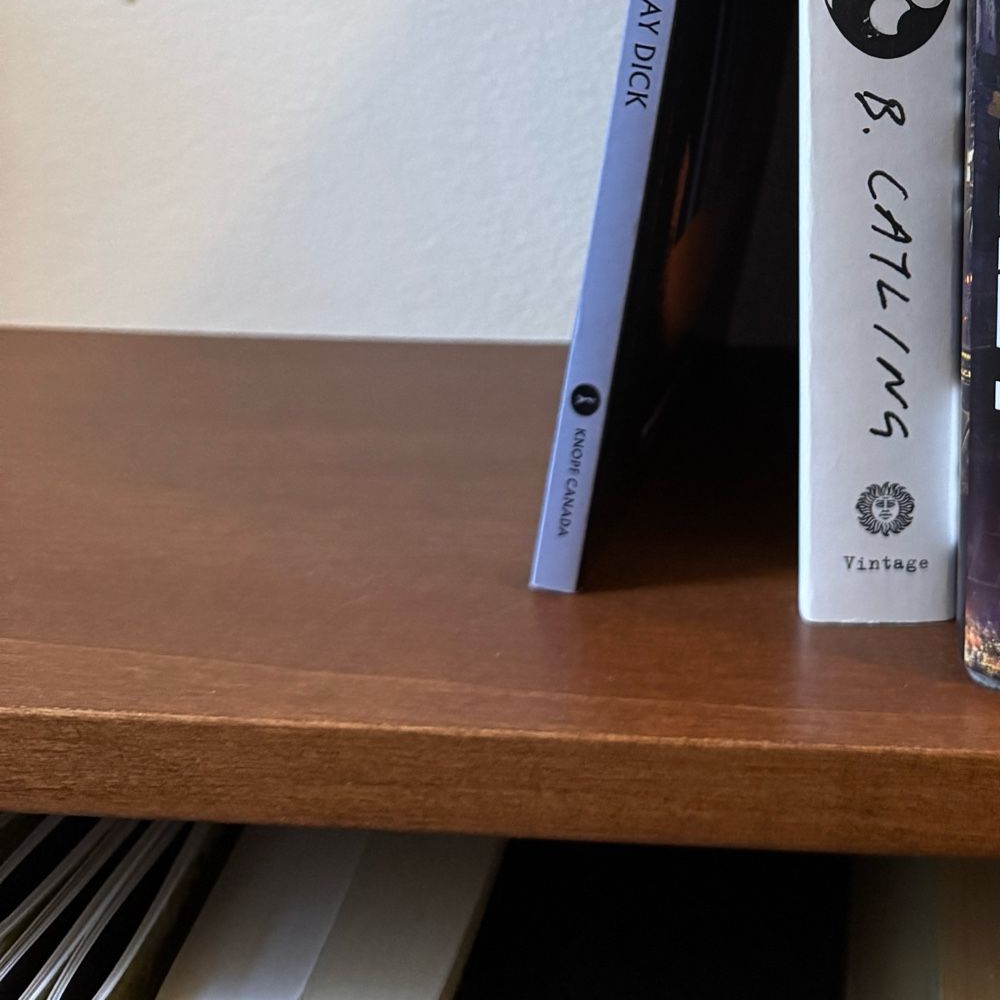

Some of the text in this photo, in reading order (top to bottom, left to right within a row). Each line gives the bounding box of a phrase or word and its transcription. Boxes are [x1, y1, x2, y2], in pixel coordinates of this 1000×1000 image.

[625, 43, 656, 109] DICK
[855, 90, 912, 439] B. CATLING
[558, 427, 587, 537] KNOPF CANADA
[843, 554, 930, 573] Vintage
